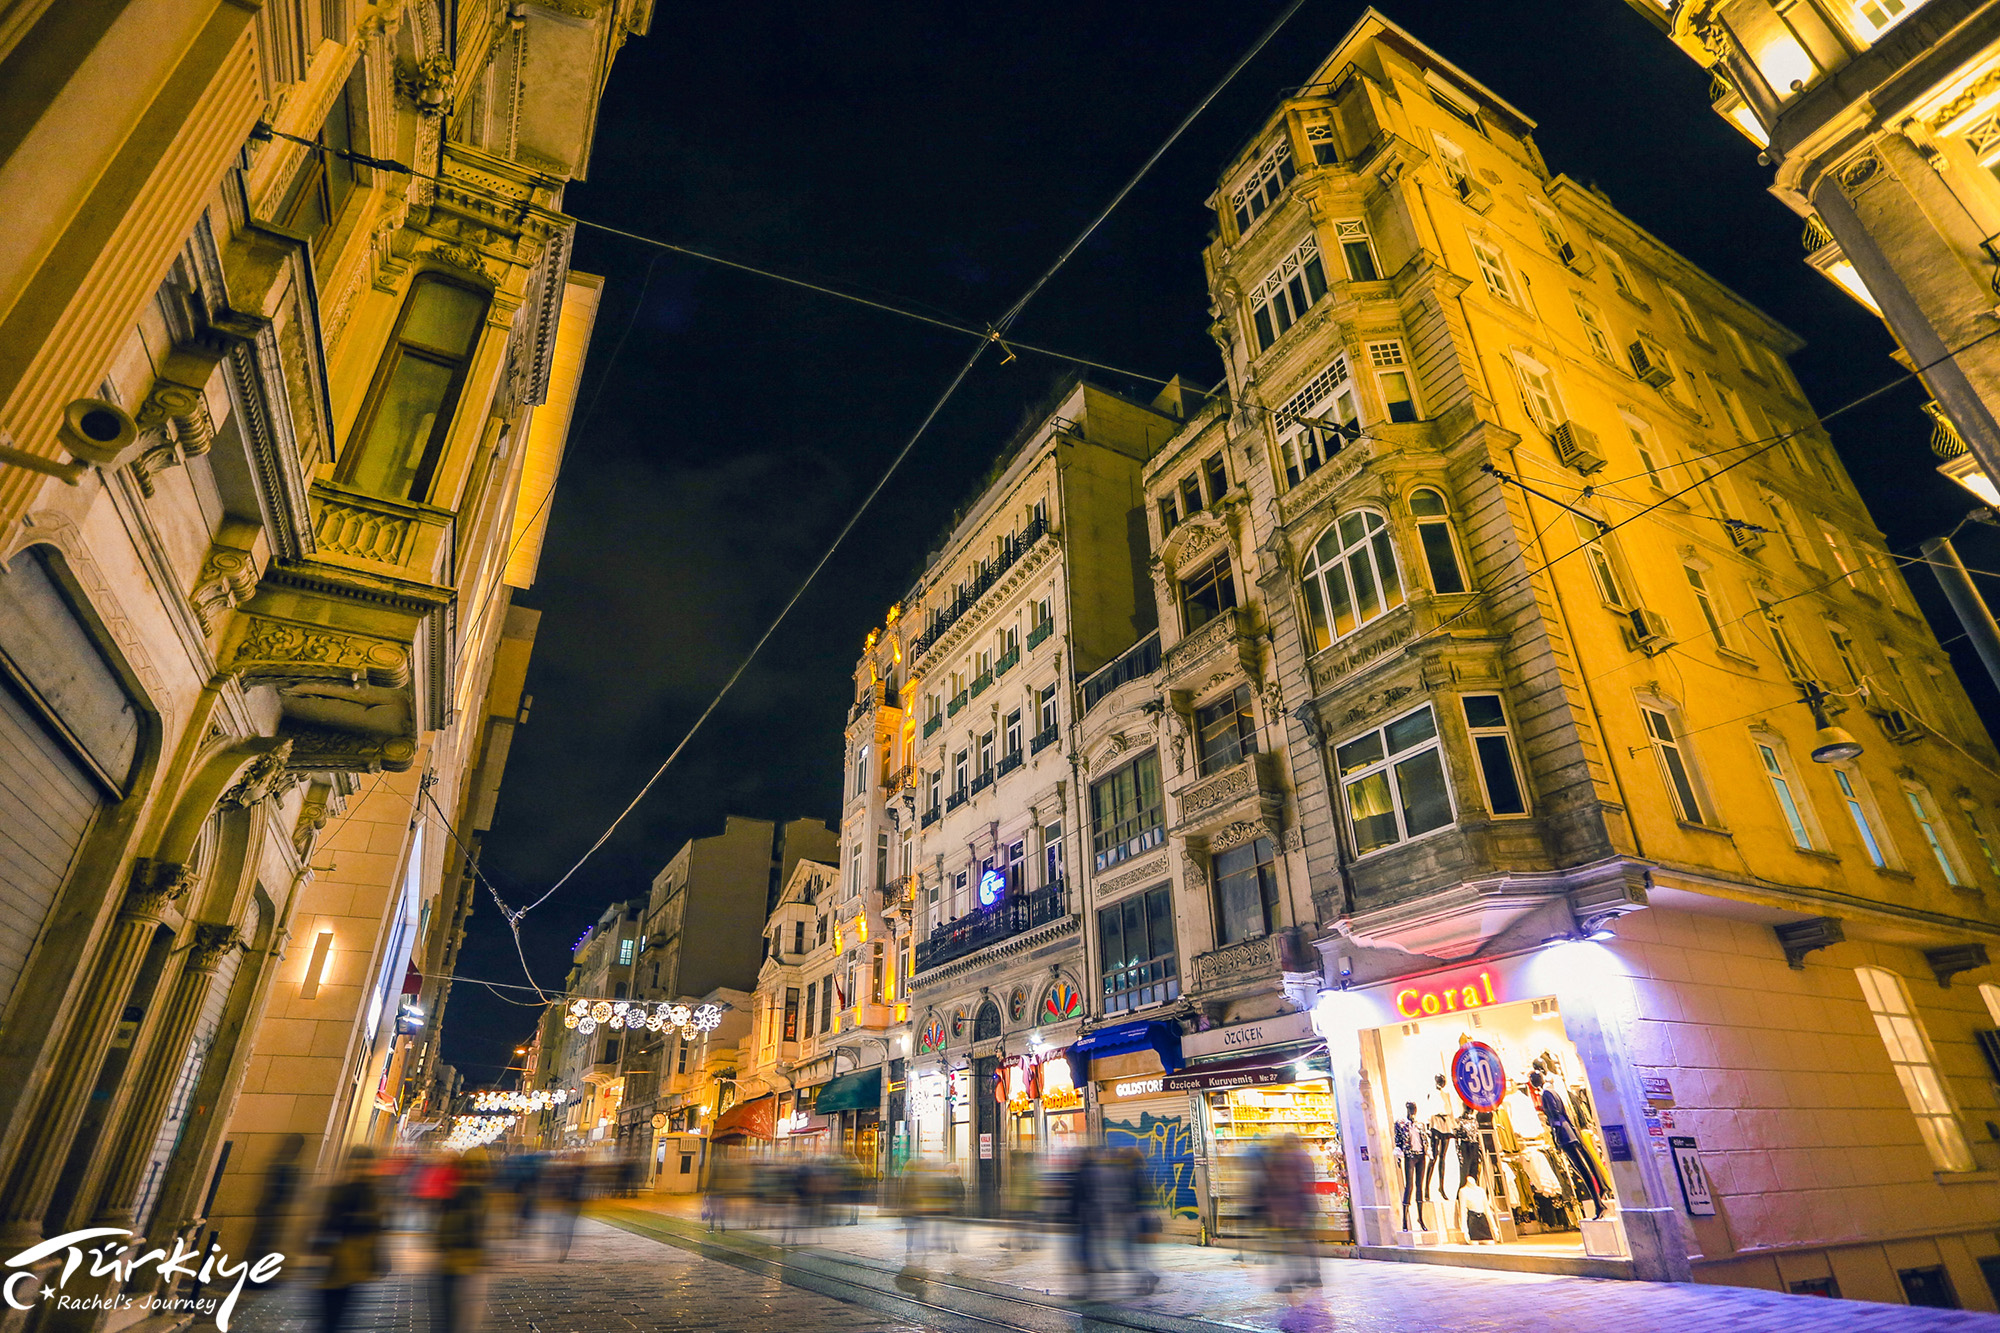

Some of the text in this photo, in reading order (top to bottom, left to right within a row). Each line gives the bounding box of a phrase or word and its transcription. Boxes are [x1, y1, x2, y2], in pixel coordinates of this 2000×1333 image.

[1396, 972, 1497, 1019] Coral
[1224, 1027, 1263, 1046] ÖZÇİÇEK
[1170, 1079, 1201, 1090] Özçiçek
[1208, 1074, 1254, 1087] Kuruyemiş
[1465, 1060, 1494, 1093] 30
[1115, 1079, 1163, 1097] GOLDSTORE
